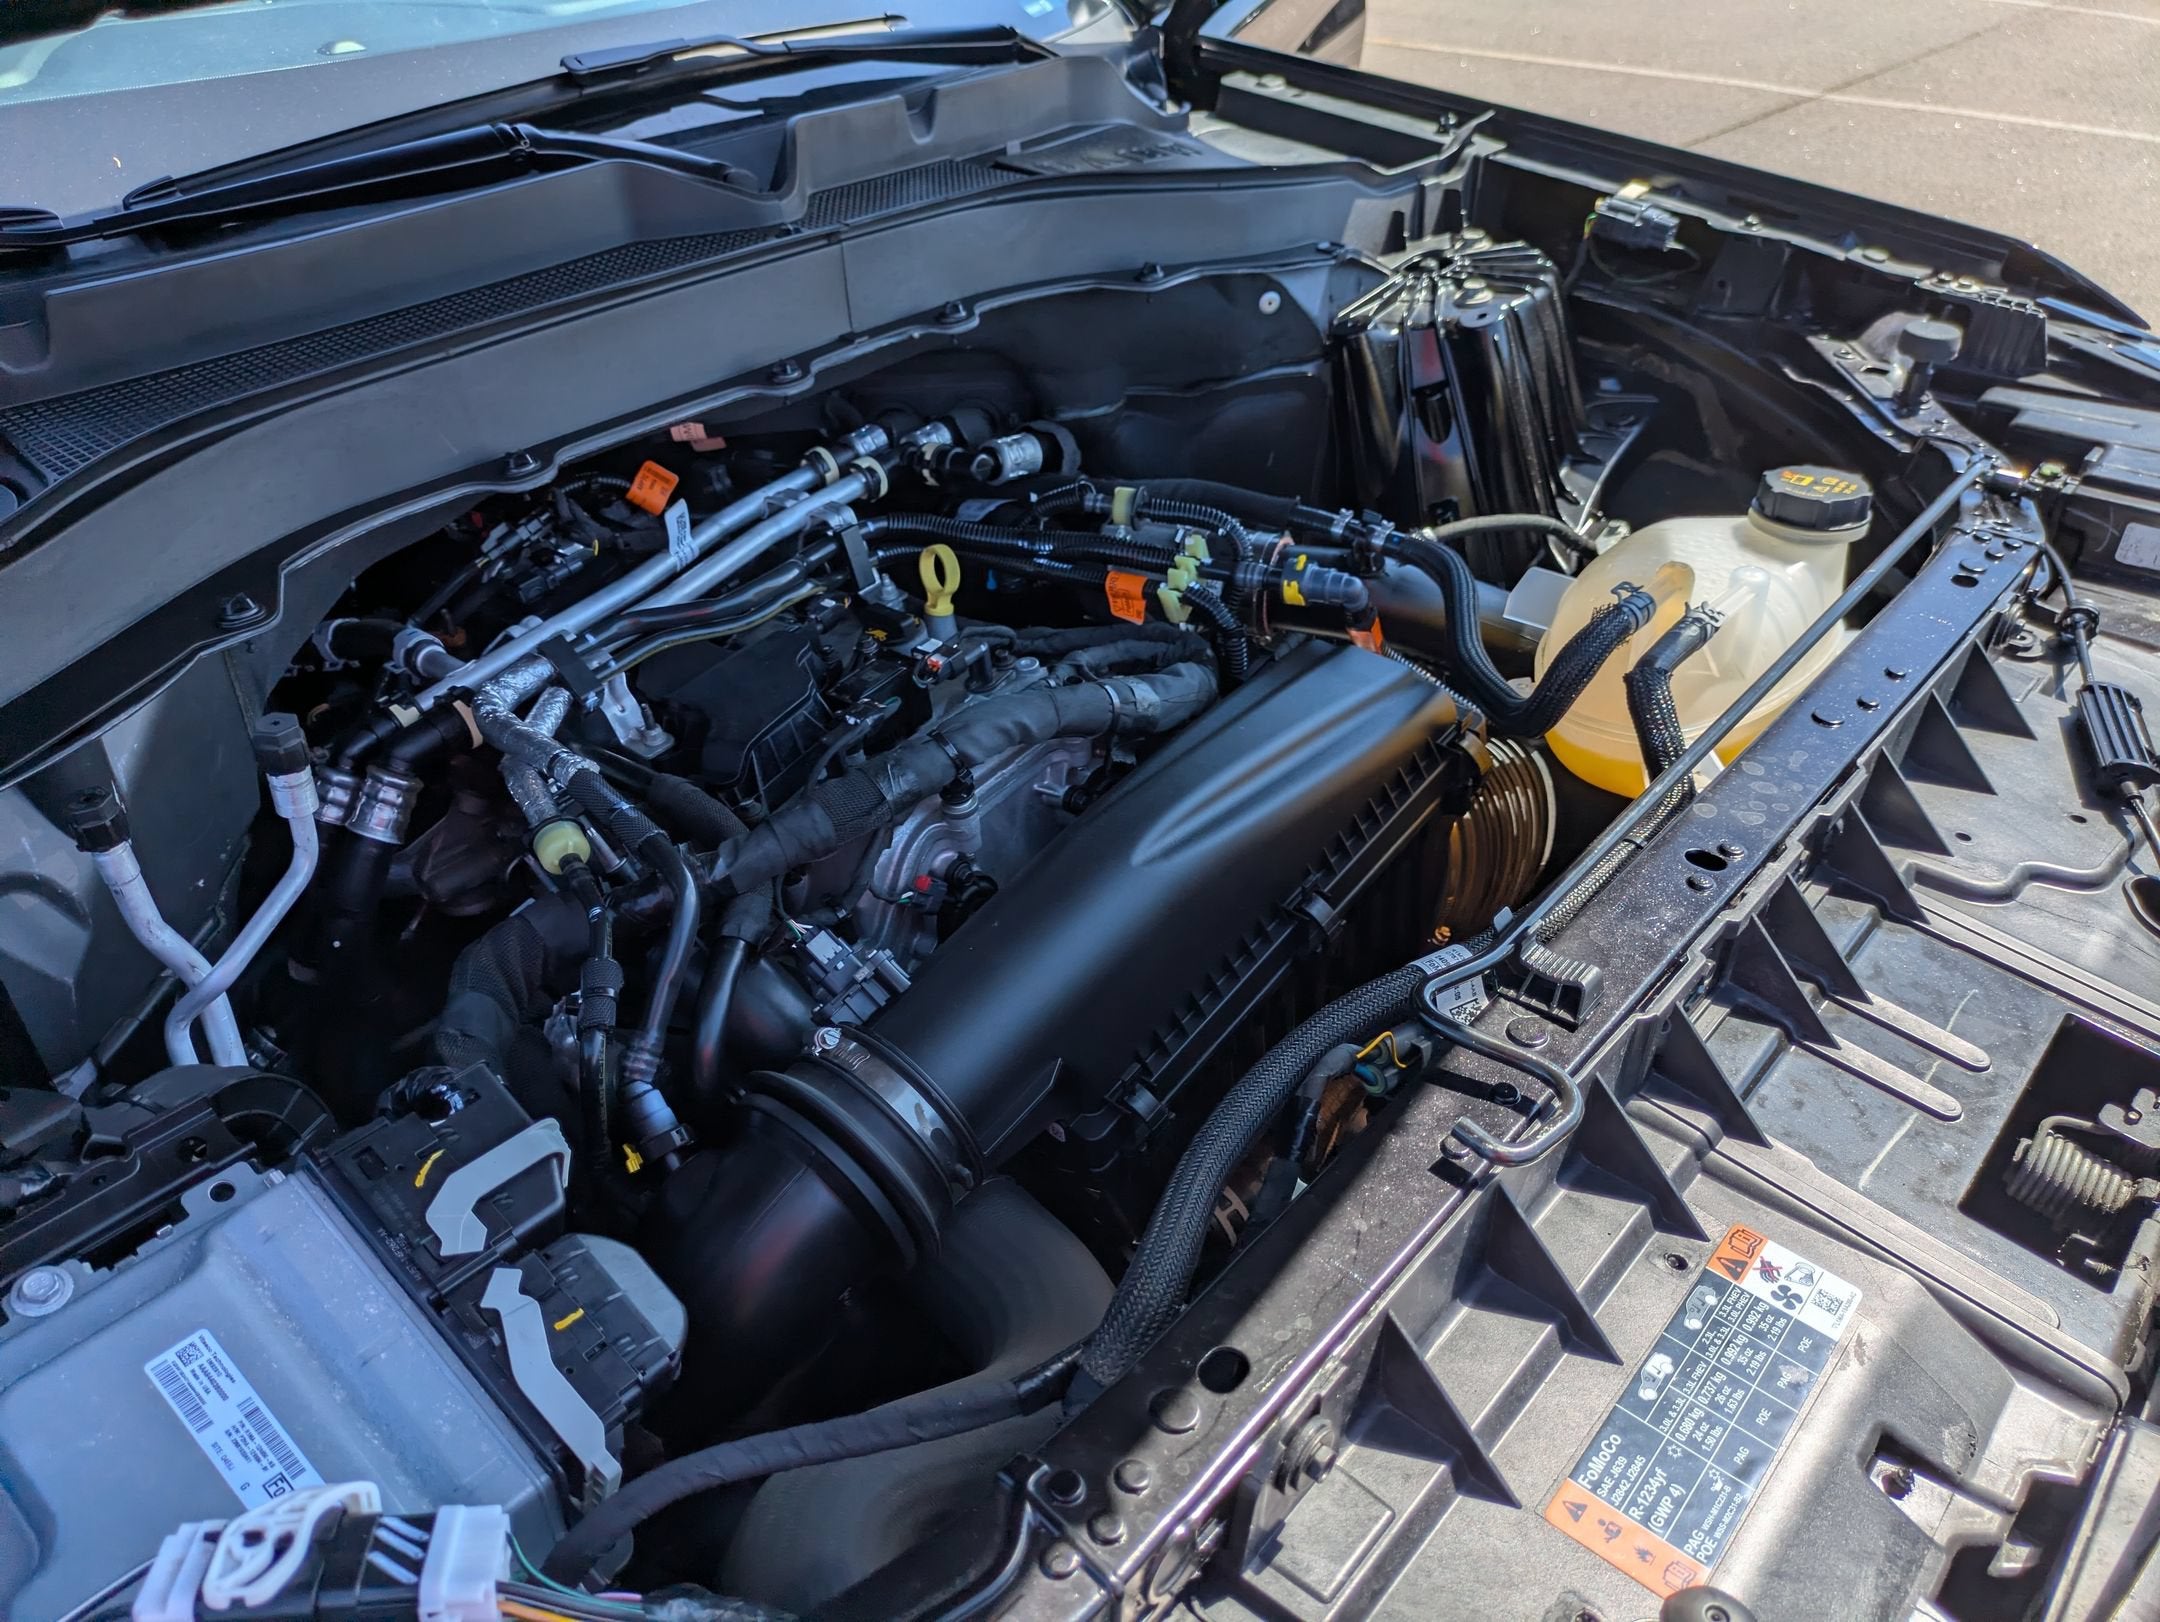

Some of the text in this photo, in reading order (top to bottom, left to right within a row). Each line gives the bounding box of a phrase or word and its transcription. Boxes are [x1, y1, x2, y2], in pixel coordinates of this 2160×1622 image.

[1718, 1286, 1742, 1318] 3.3L FHEV
[1726, 1291, 1751, 1323] 3.0L PHEV
[1741, 1299, 1770, 1332] 0.992 kg
[1757, 1313, 1774, 1332] 35 oz
[1766, 1315, 1788, 1342] 2.19 lbs
[1704, 1323, 1731, 1358] 3.0L & 3.3L
[1719, 1332, 1749, 1366] 0.992 kg
[1797, 1335, 1813, 1353] POE
[1736, 1346, 1754, 1366] 35 oz
[1745, 1348, 1767, 1376] 2.19 lbs
[1681, 1360, 1708, 1394] 3.3L FHEV
[1696, 1369, 1727, 1405] 0.737 kg
[1776, 1370, 1792, 1389] PAG
[1713, 1384, 1732, 1405] 26 oz
[1722, 1386, 1745, 1415] 1.63 lbs
[1658, 1394, 1686, 1432] 3.0L & 3.3L
[1674, 1405, 1705, 1442] 0.680 kg
[1755, 1407, 1772, 1426] POE
[1691, 1421, 1710, 1442] 24 oz
[1700, 1423, 1723, 1452] 1.50 lbs
[1576, 1430, 1623, 1489] FoMoCo
[1733, 1445, 1750, 1465] PAG
[240, 1482, 250, 1491] G
[1595, 1454, 1628, 1498] SAE J639
[1608, 1453, 1646, 1506] J2842 J2845
[1627, 1465, 1671, 1522] R-1234yf
[1646, 1481, 1687, 1534] (GWP 4)
[1682, 1527, 1705, 1555] PAG
[1695, 1535, 1718, 1563] POE
